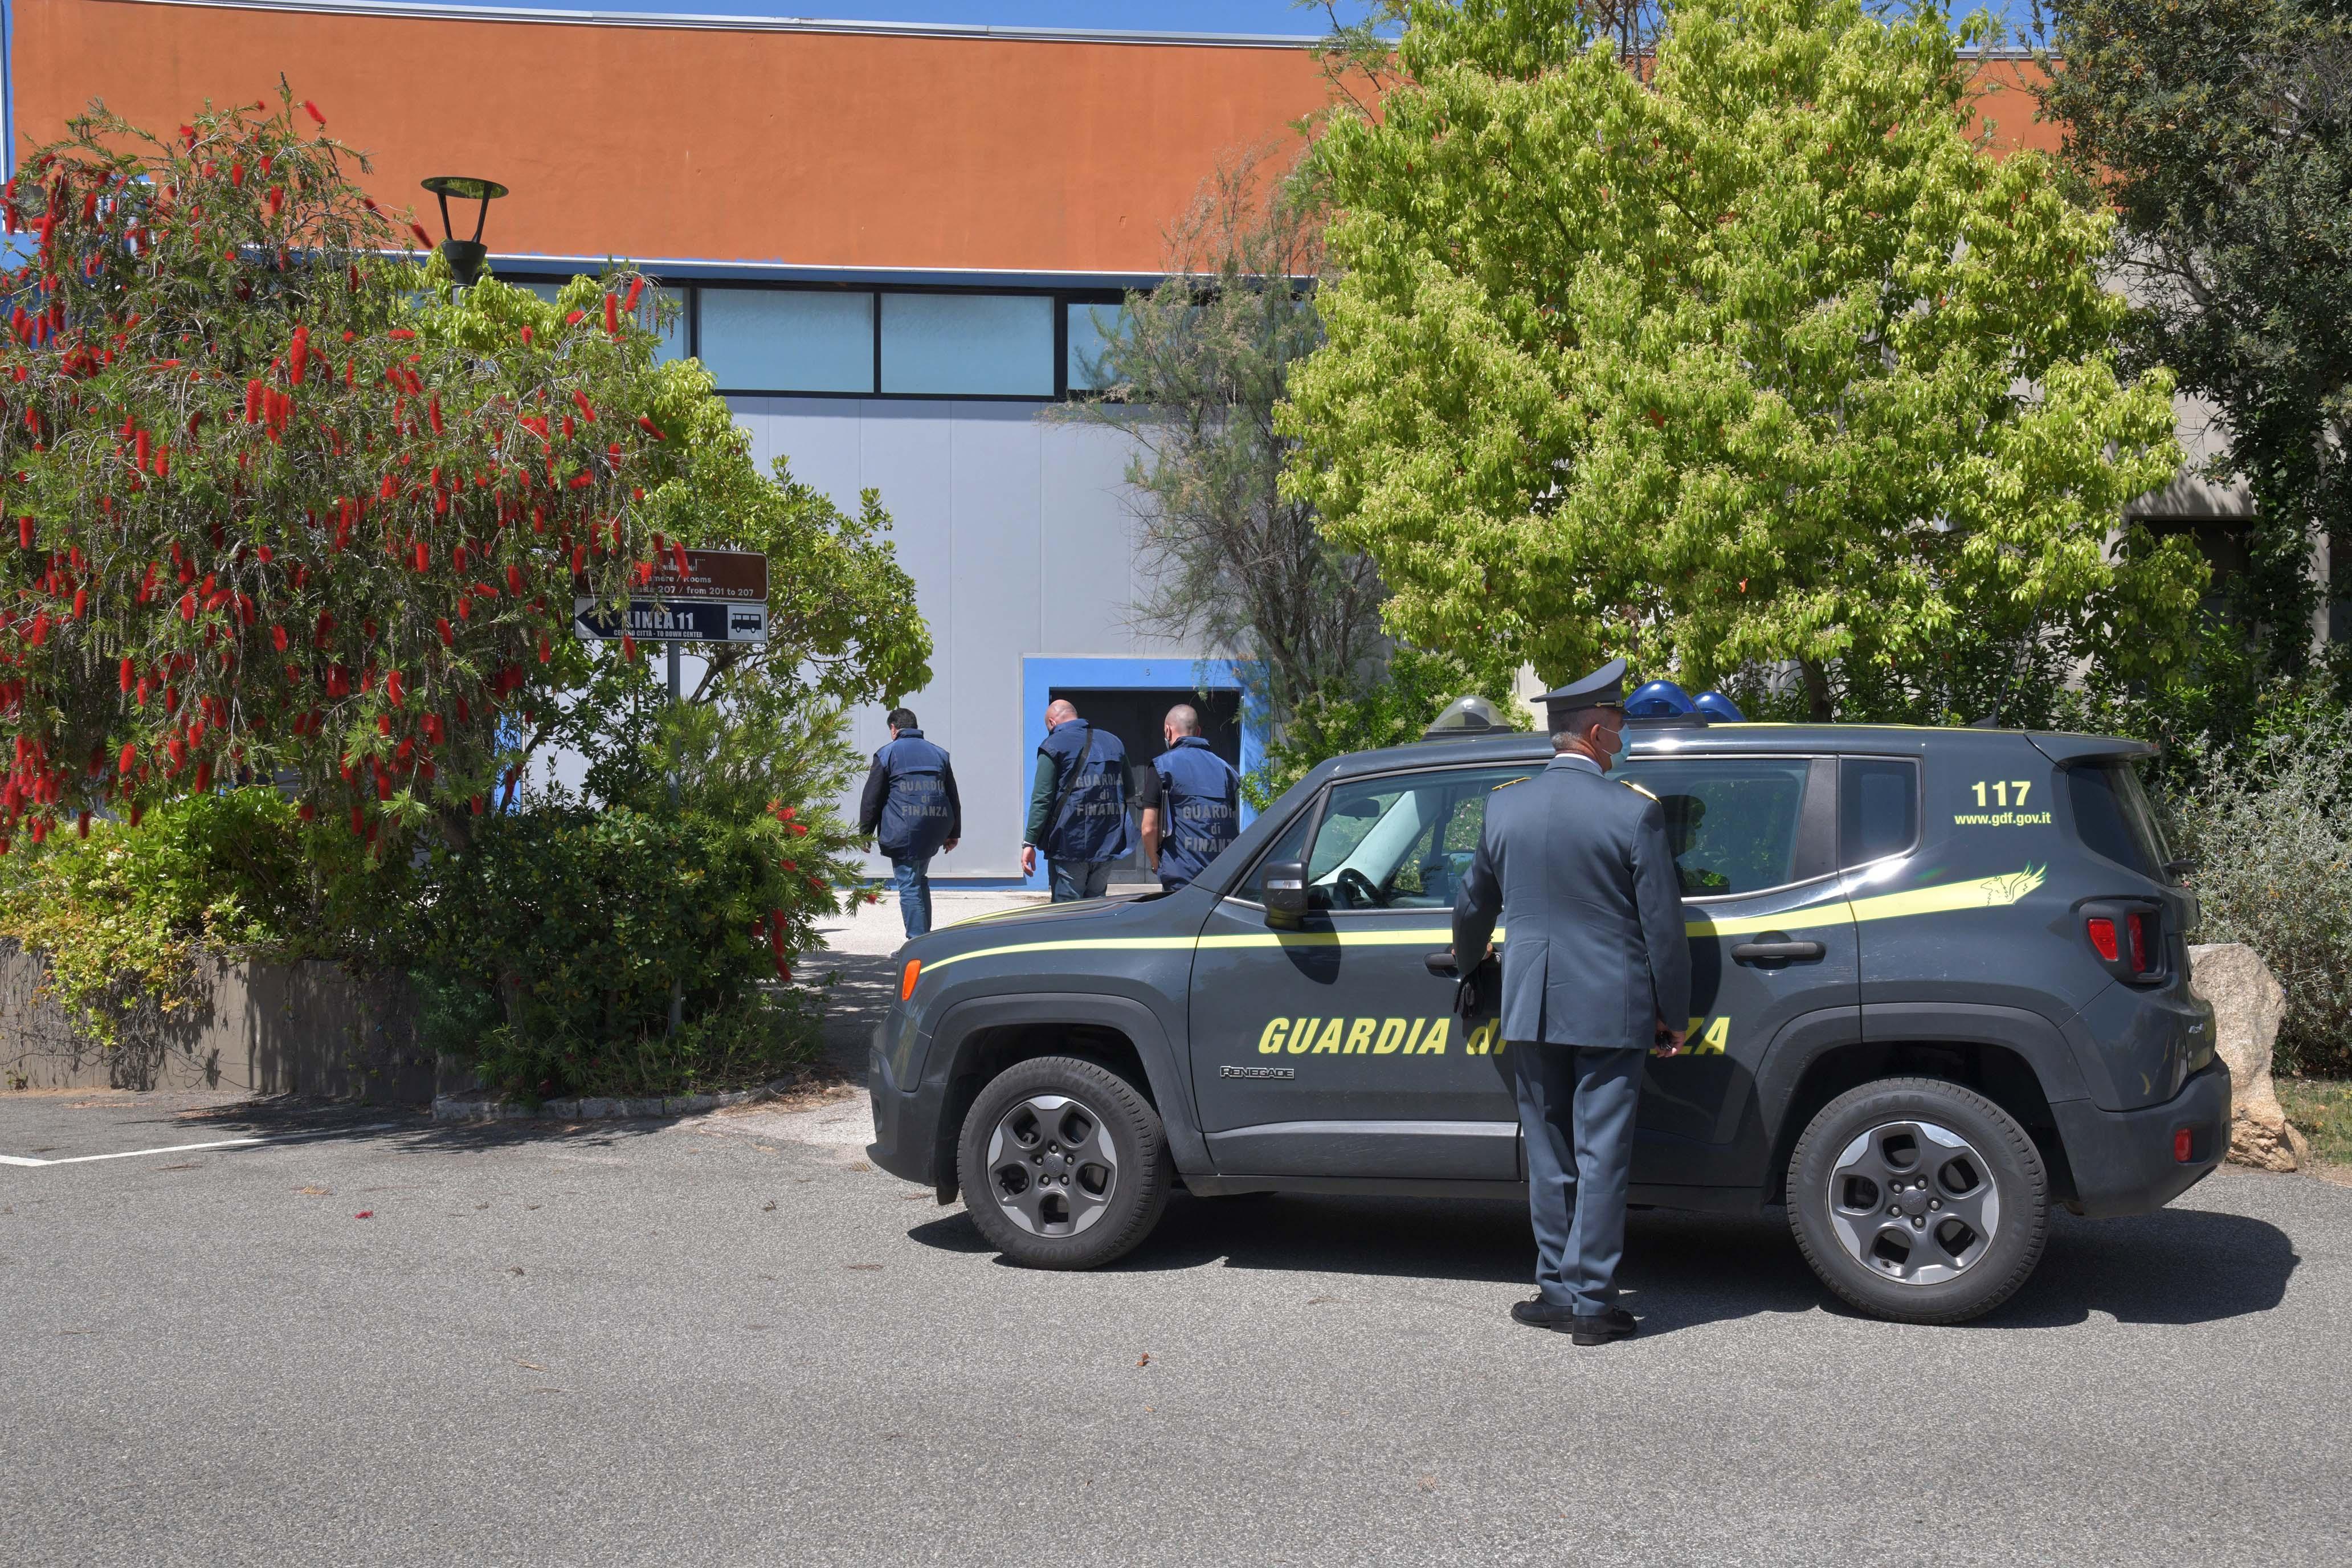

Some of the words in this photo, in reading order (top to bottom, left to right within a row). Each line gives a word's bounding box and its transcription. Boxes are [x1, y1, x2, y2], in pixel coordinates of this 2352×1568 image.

[626, 611, 675, 629] LINEA
[676, 612, 693, 630] 11
[1075, 773, 1124, 787] GUARDIA
[921, 793, 930, 803] di
[1099, 788, 1109, 800] di
[1971, 781, 2031, 807] 117
[902, 805, 948, 817] FINANZA
[1954, 812, 2051, 826] www.gdf.gov.it
[1211, 822, 1220, 835] di
[1257, 1017, 1451, 1054] GUARDIA
[1220, 1065, 1295, 1079] RENEGADE
